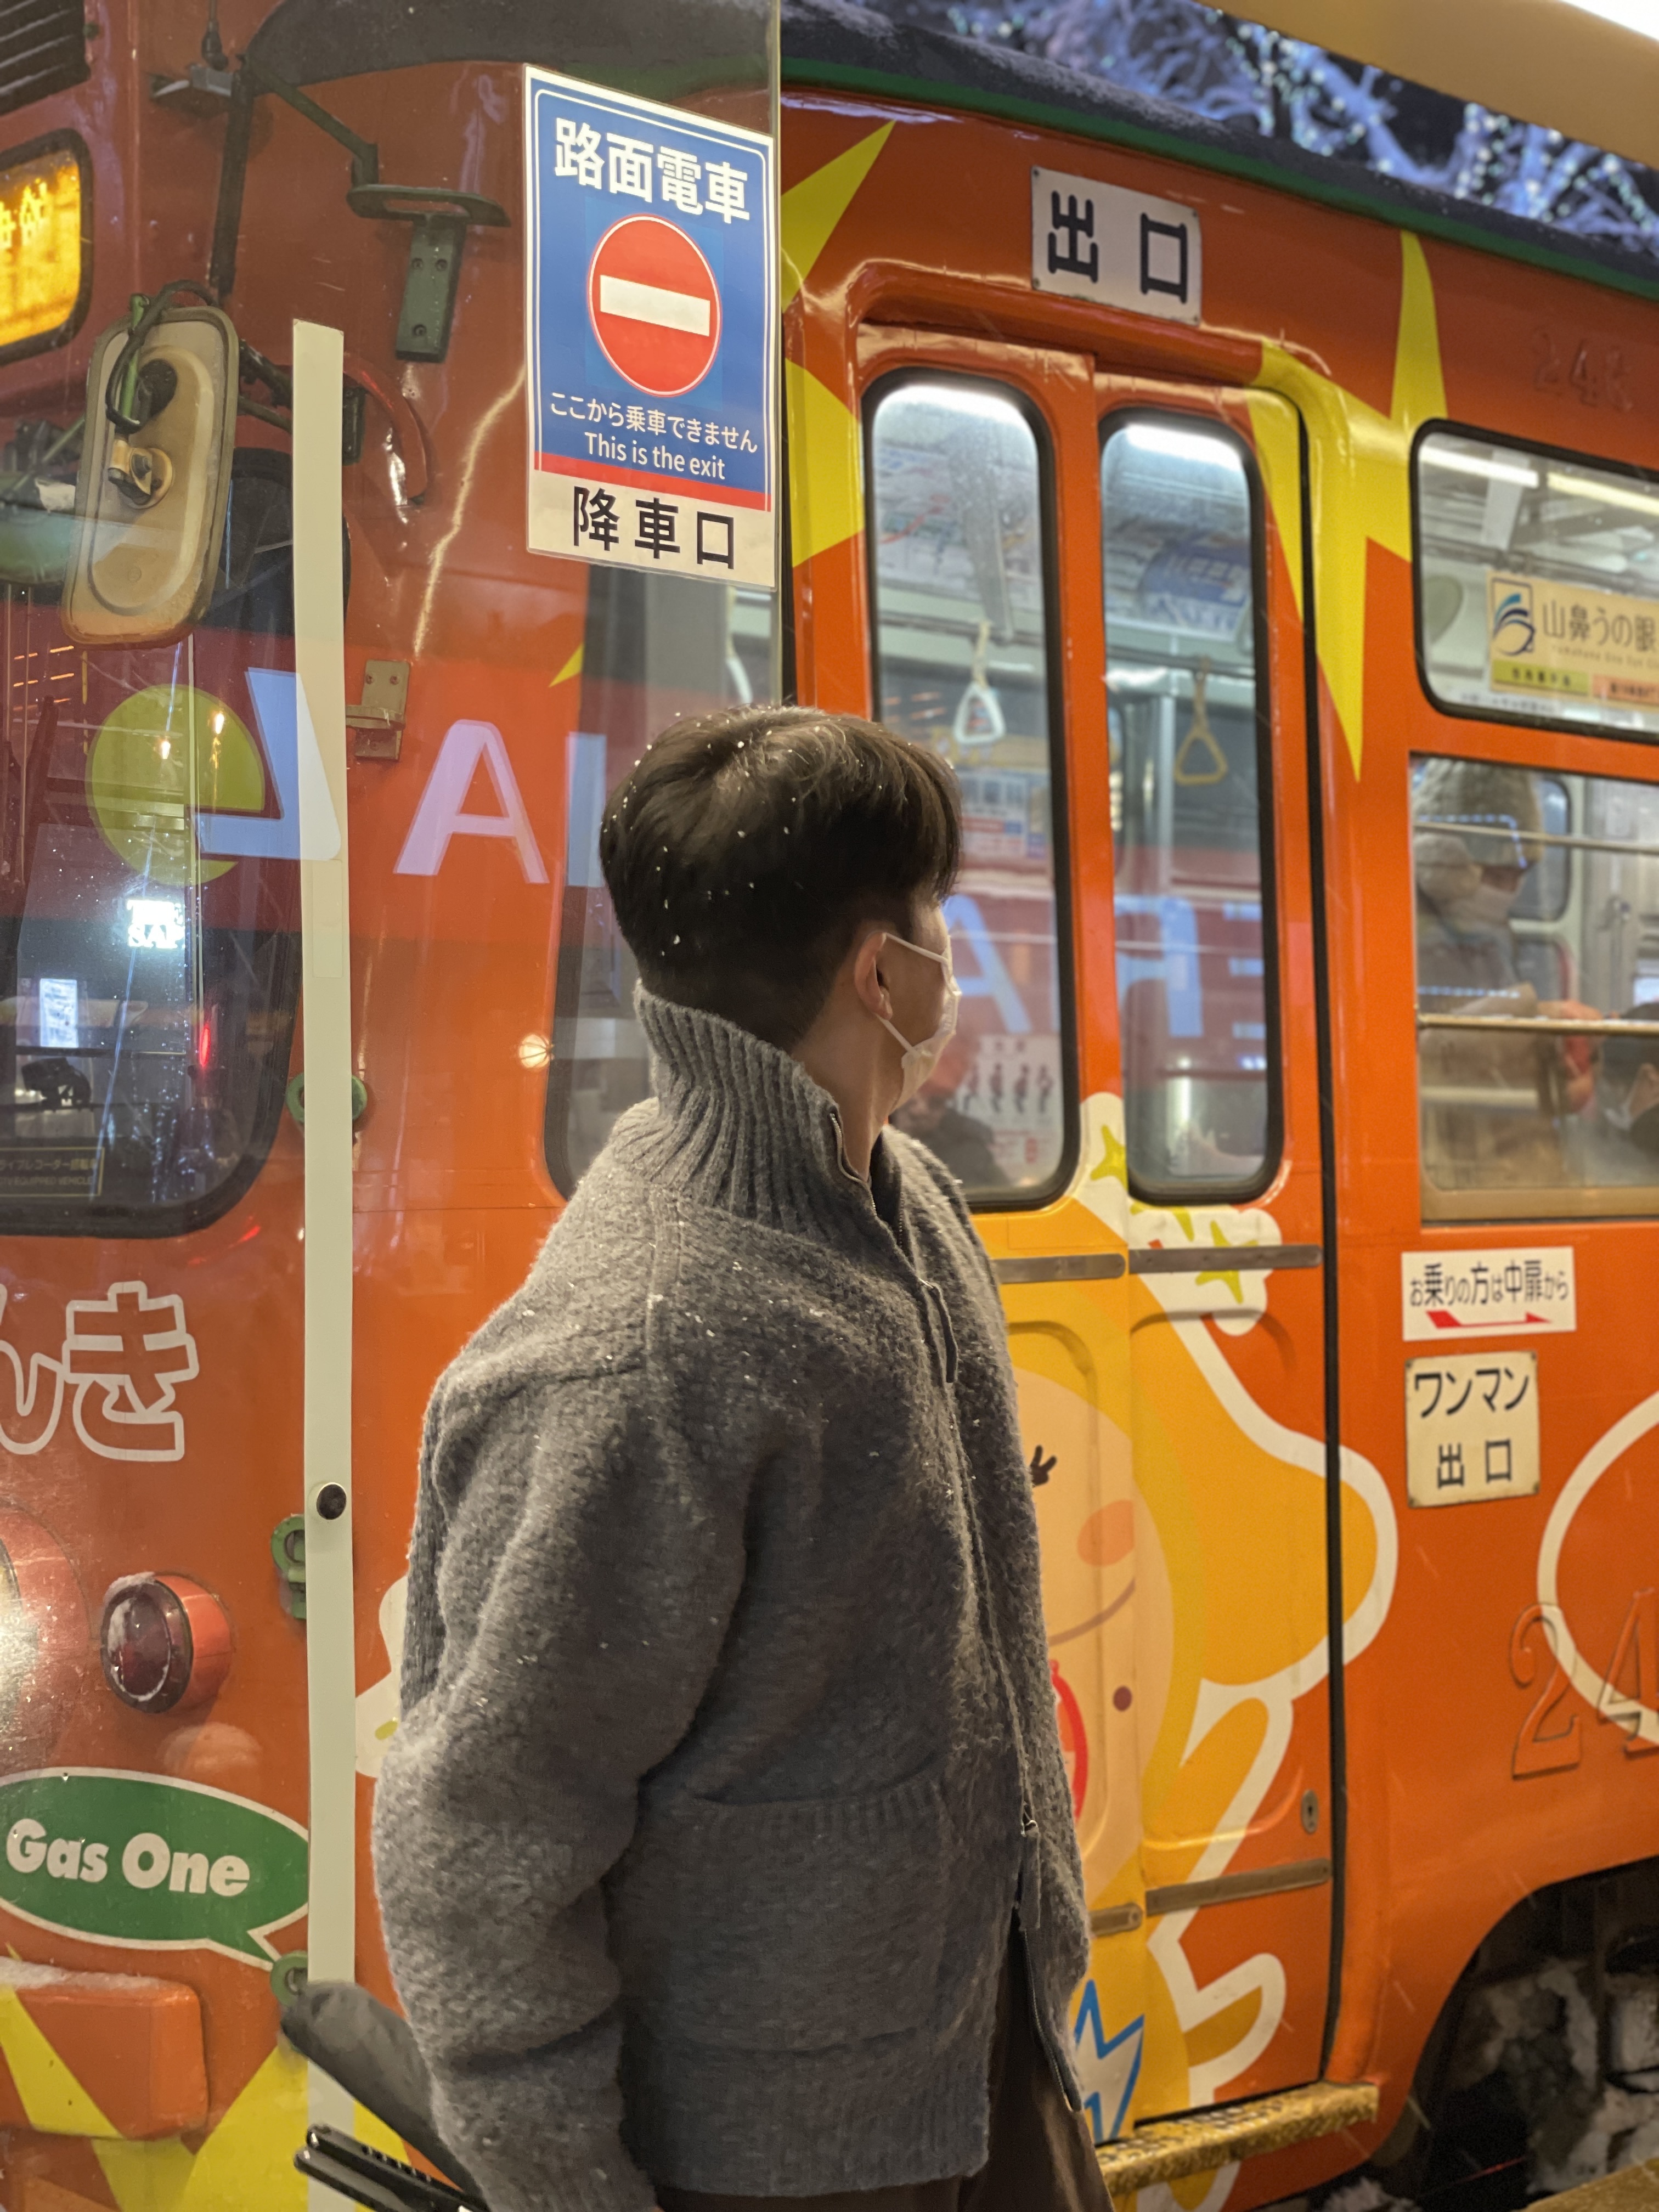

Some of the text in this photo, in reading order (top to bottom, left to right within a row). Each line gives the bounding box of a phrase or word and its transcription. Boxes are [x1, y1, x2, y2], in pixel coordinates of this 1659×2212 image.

[554, 117, 750, 224] 路面電車
[1048, 190, 1188, 304] 出口
[550, 392, 758, 453] ここから乗車できません
[585, 432, 725, 479] This is the exit
[574, 486, 734, 569] 降車口
[1410, 1260, 1568, 1307] お乗りの方は中扉から
[1414, 1367, 1530, 1419] ワンマン
[1437, 1438, 1512, 1490] 出口
[6, 1818, 250, 1897] Gas One
